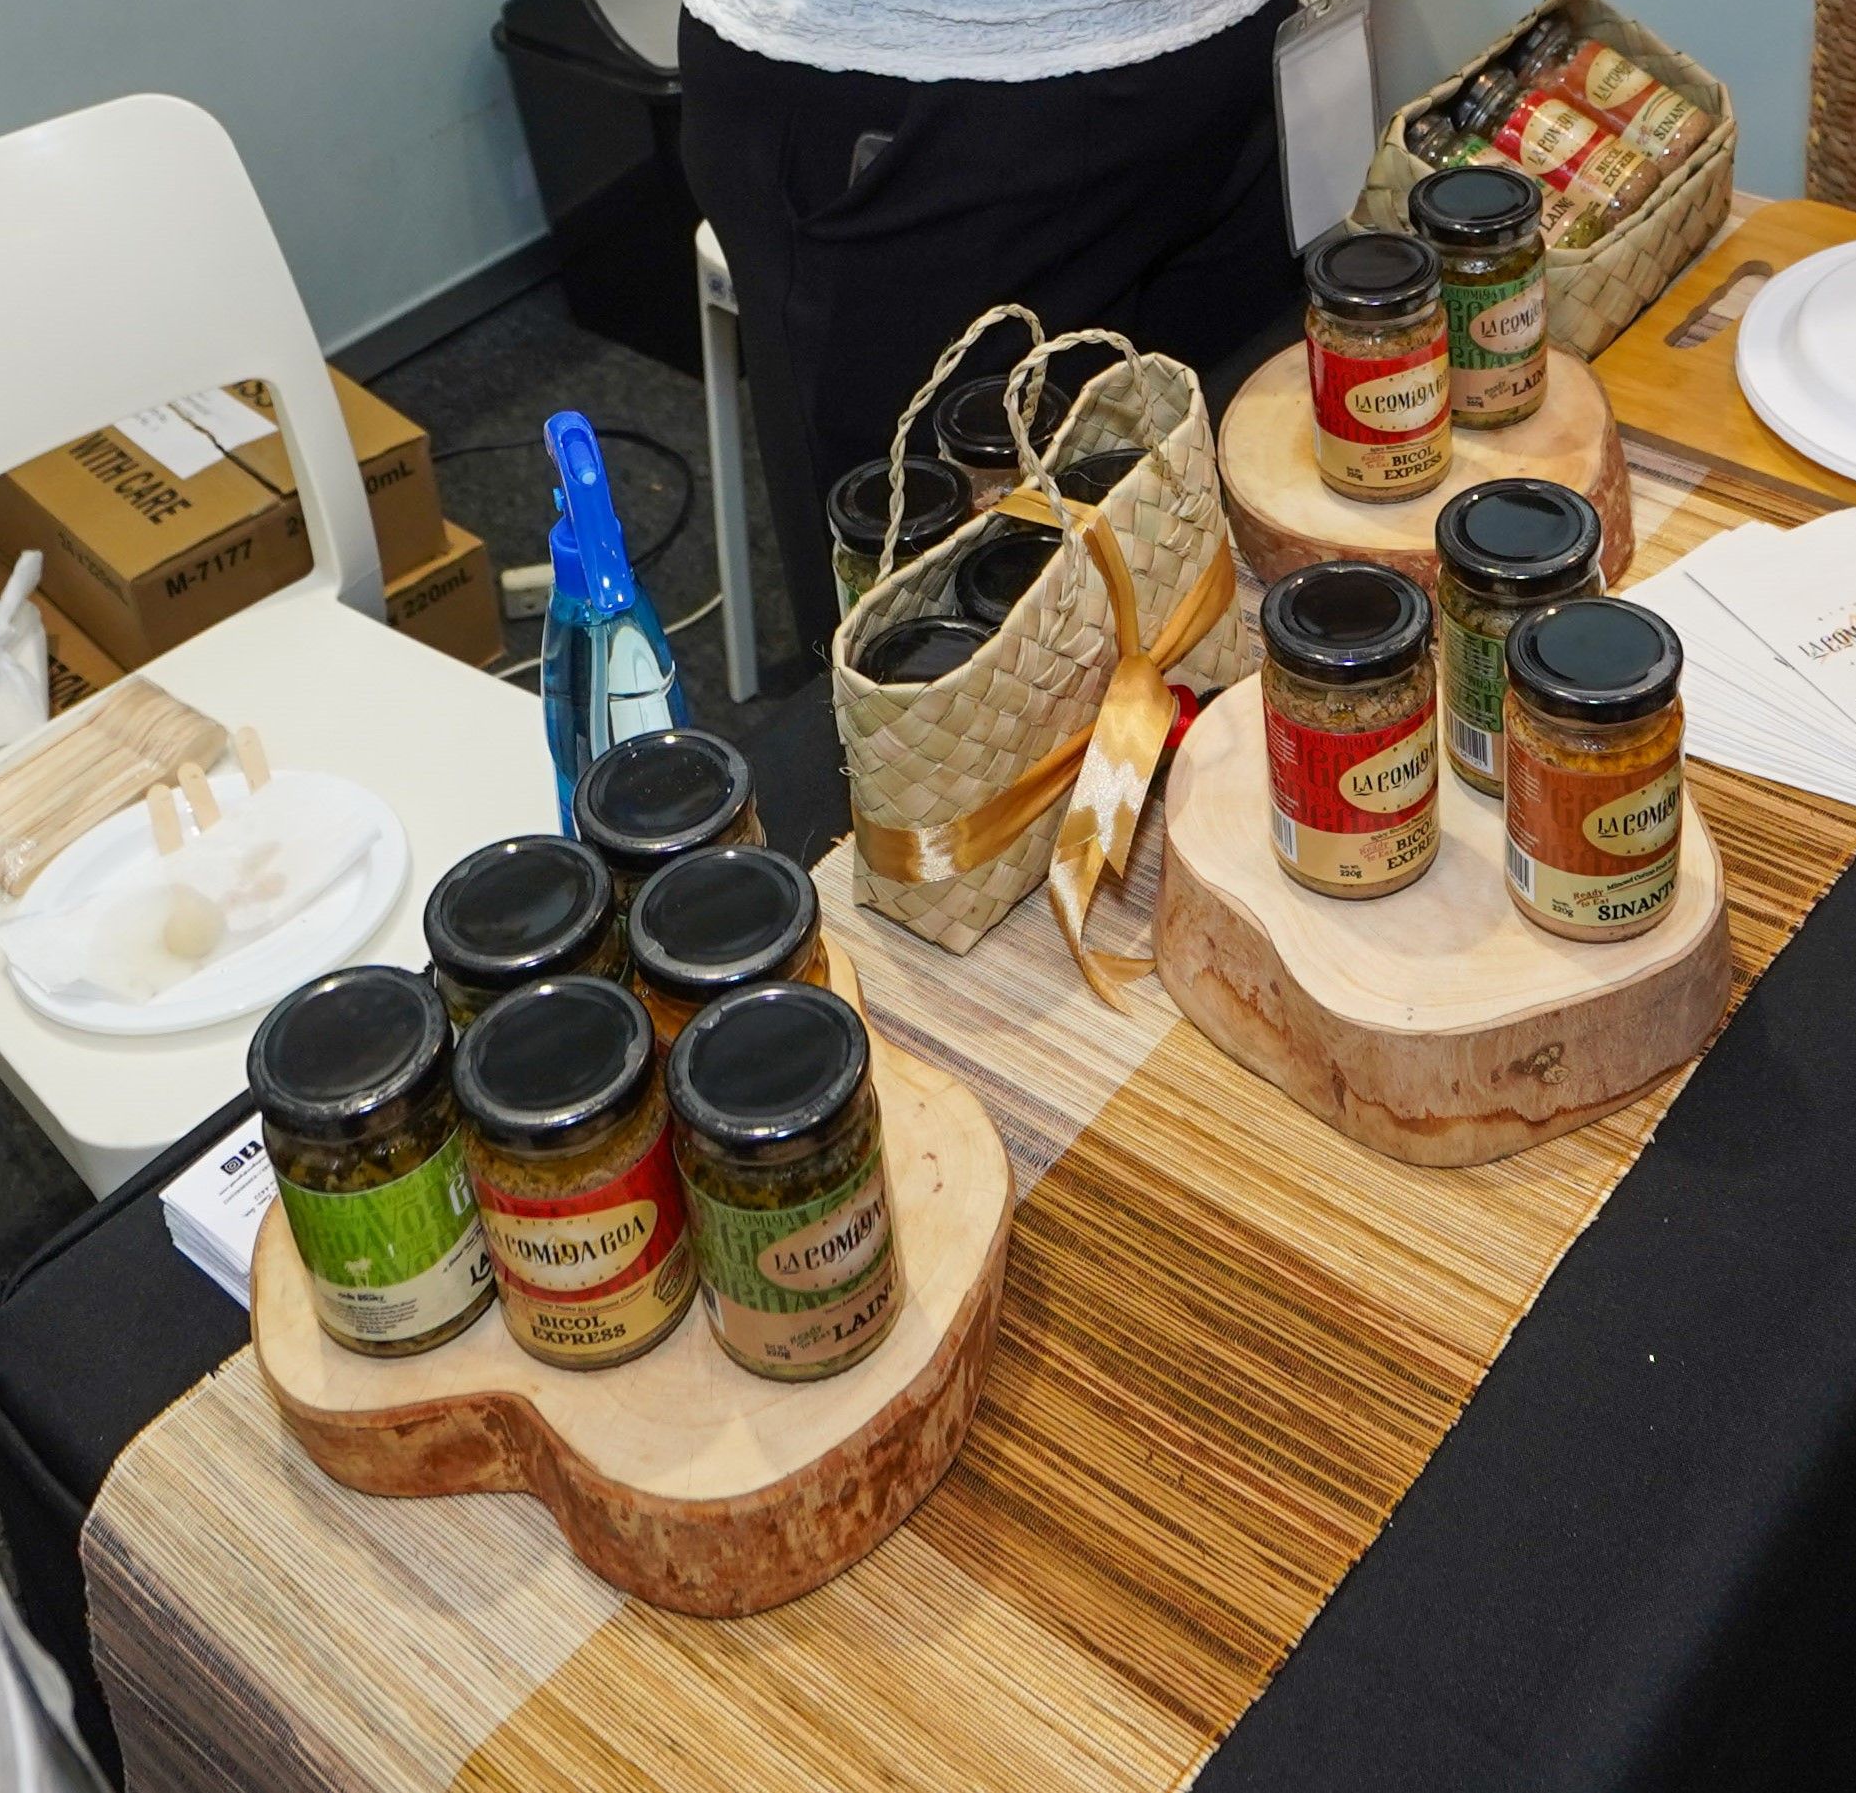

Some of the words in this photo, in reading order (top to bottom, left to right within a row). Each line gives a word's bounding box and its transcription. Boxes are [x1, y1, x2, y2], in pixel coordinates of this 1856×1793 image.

[1481, 320, 1497, 338] LA
[1354, 393, 1372, 414] LA
[1375, 383, 1436, 413] COMIDA
[1384, 451, 1443, 481] EXPRESS
[1393, 446, 1435, 468] BICOL
[69, 429, 136, 485] WITH
[113, 464, 194, 526] CARE
[165, 539, 256, 599] M-7177
[403, 566, 474, 620] 220mL
[1798, 641, 1823, 660] LA
[1353, 775, 1373, 796] LA
[1597, 817, 1620, 838] LA
[1573, 888, 1604, 900] Ready
[504, 1235, 597, 1267] COMIDA
[599, 1215, 646, 1255] GOA
[774, 1252, 800, 1275] LA
[538, 1313, 607, 1331] BICOL
[530, 1322, 628, 1346] EXPRESS
